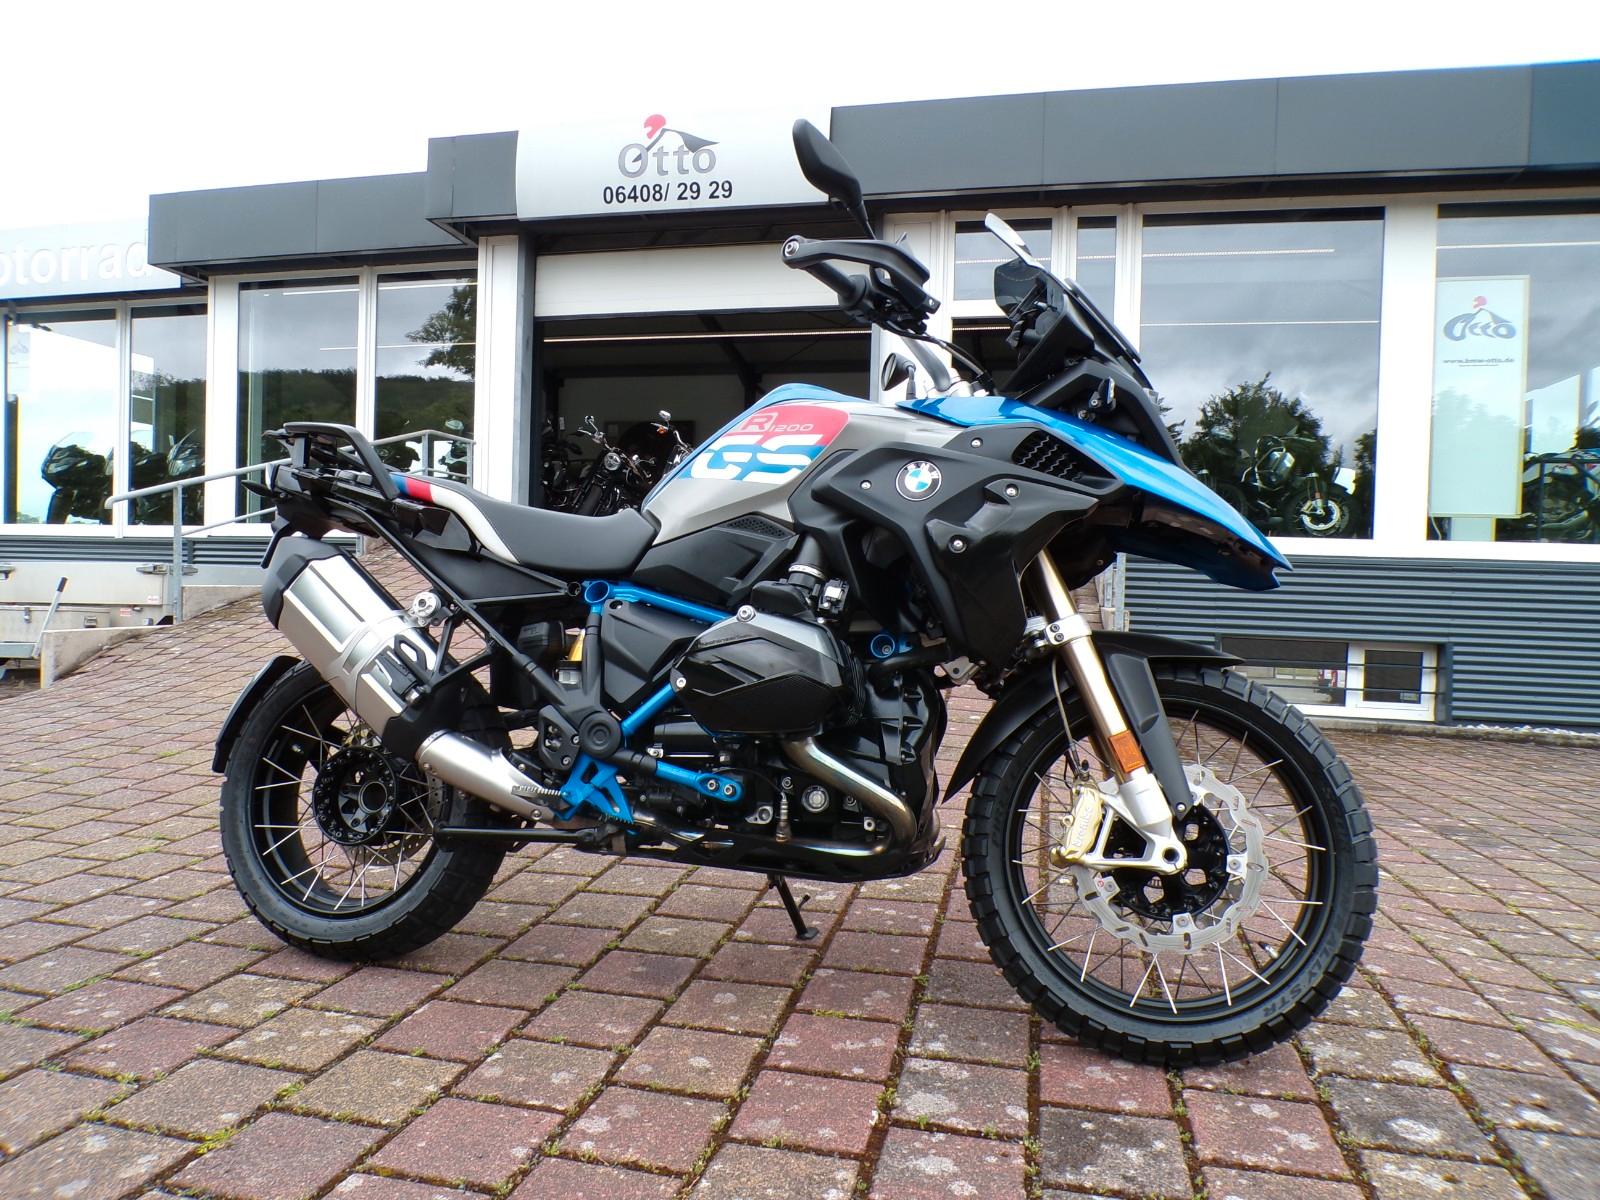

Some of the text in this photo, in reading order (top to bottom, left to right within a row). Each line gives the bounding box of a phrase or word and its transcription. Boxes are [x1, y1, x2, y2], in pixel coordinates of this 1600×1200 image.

[618, 143, 717, 179] Otto
[603, 180, 733, 205] 06408/ 29 29
[690, 433, 825, 485] GS
